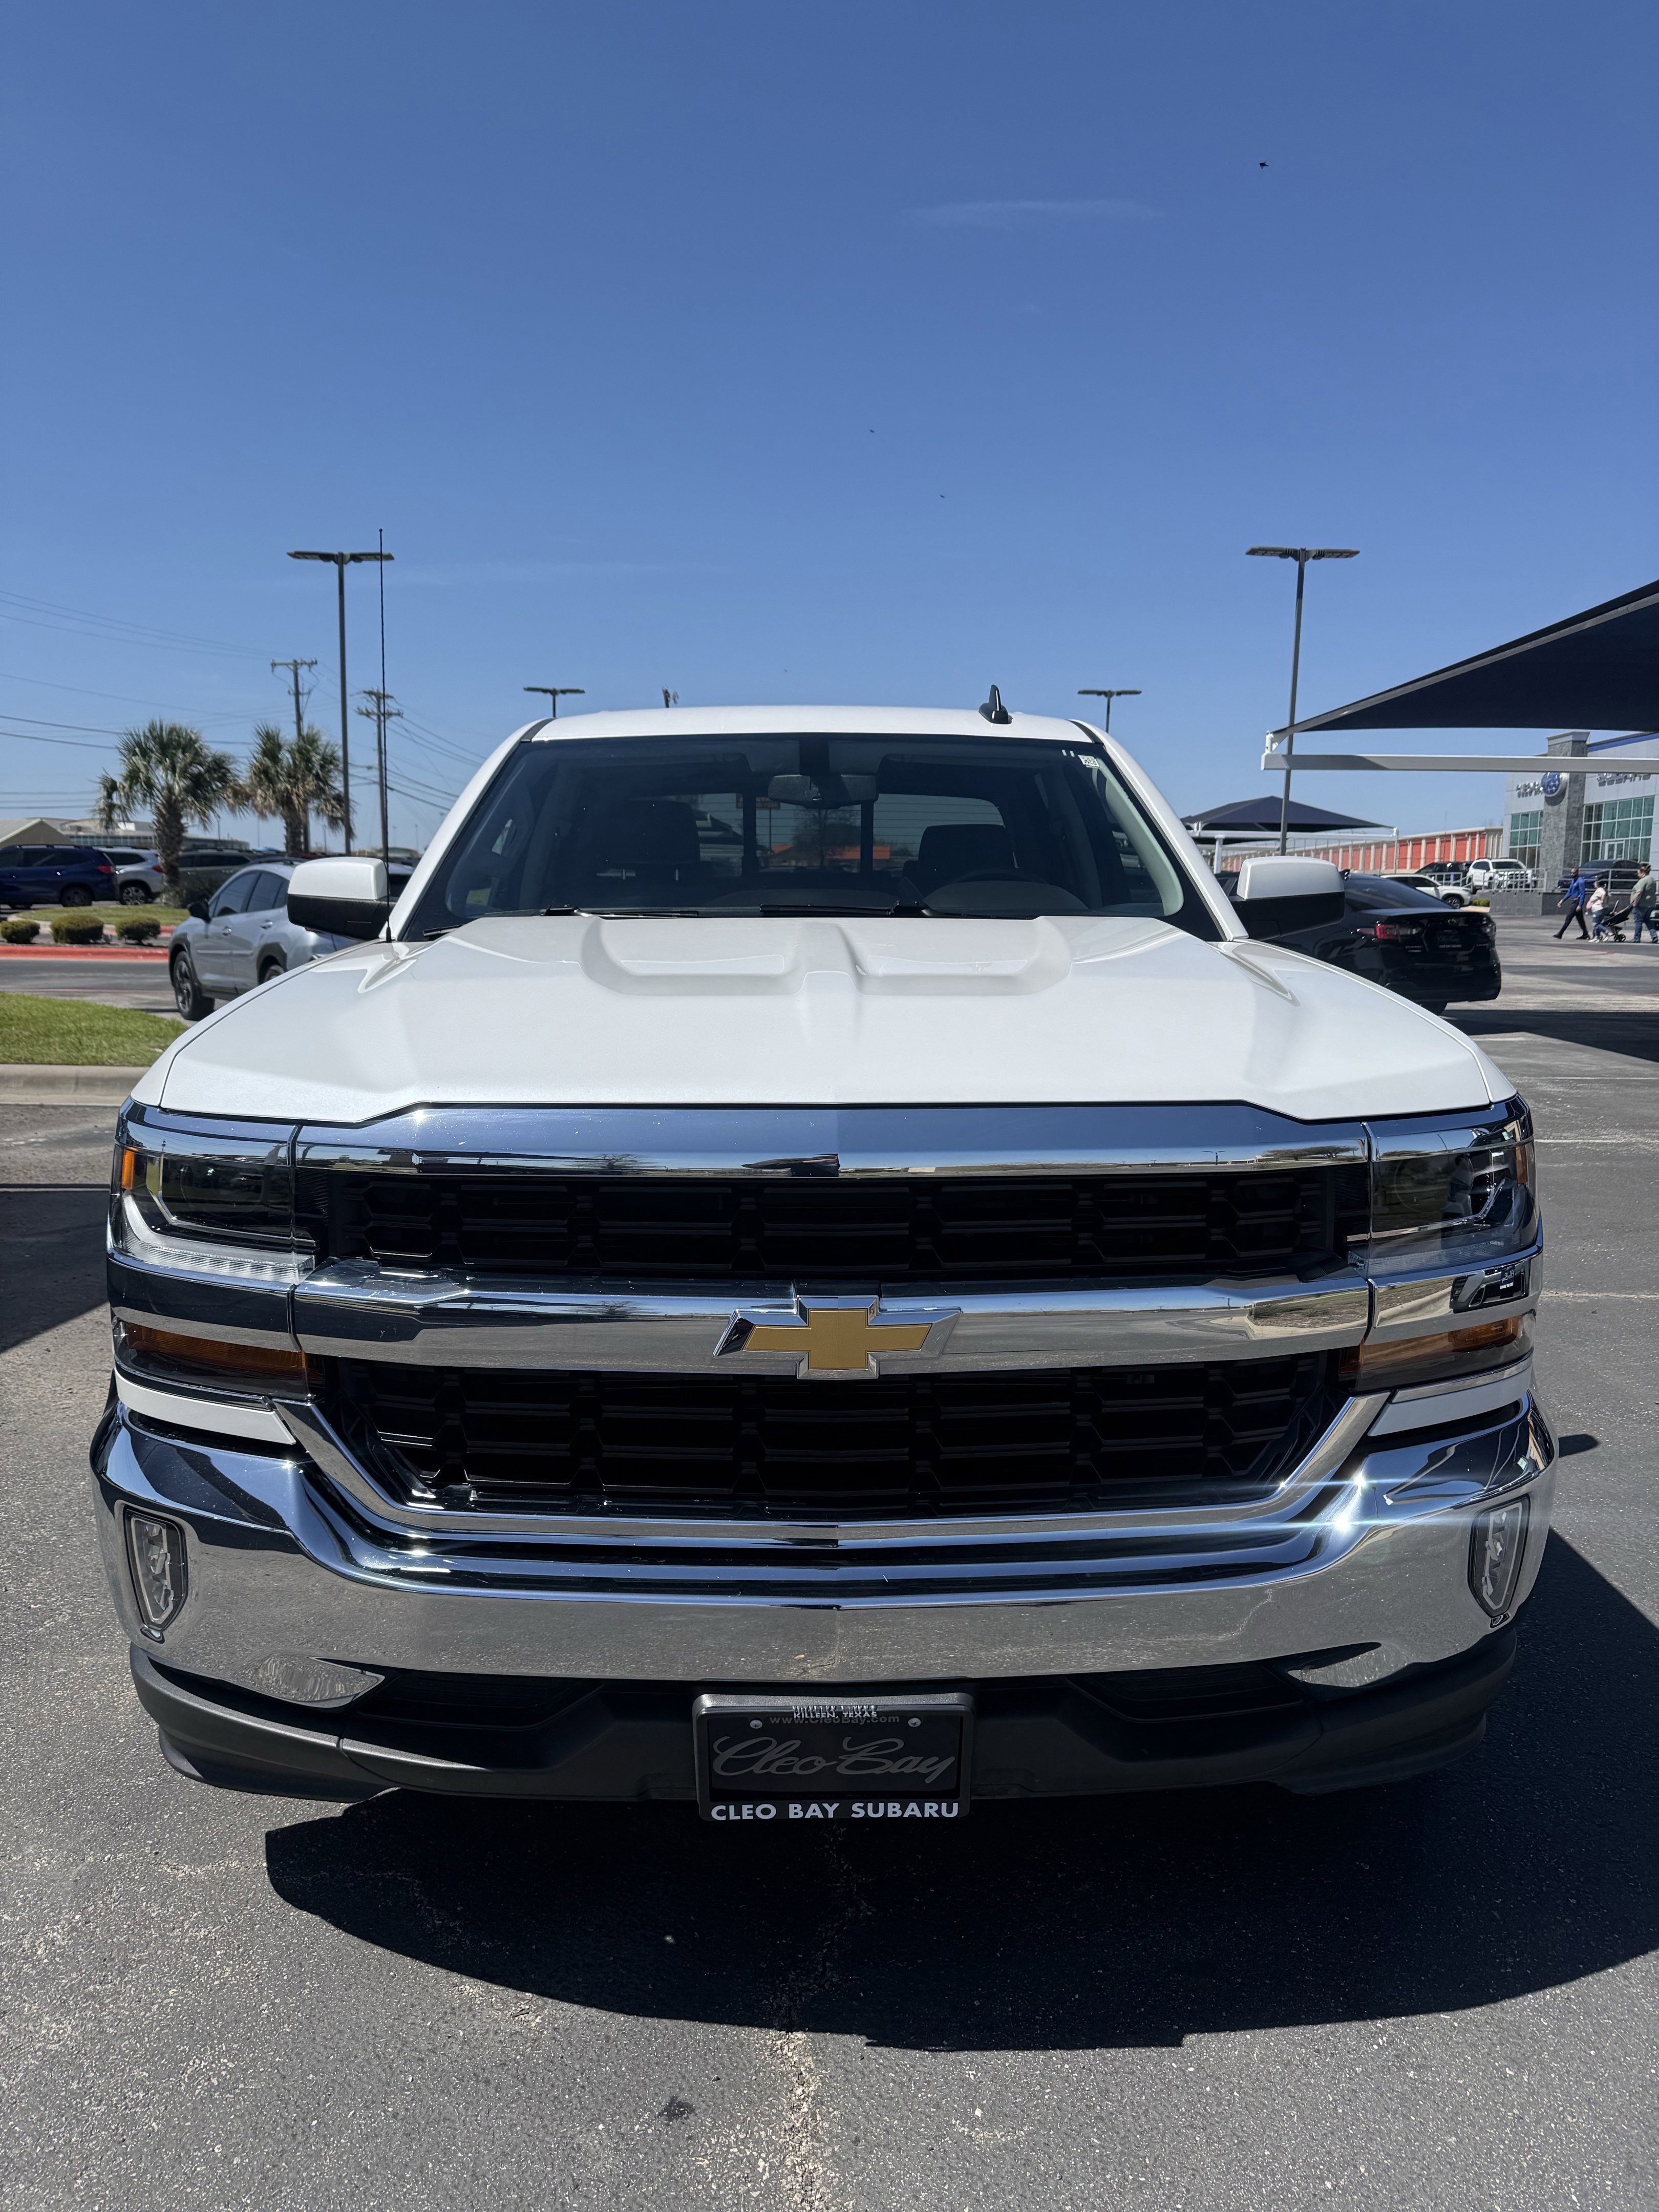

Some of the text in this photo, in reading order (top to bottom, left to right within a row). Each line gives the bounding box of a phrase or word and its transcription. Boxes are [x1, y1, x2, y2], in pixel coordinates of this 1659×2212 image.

[713, 1736, 955, 1783] Cleo Bay
[711, 1802, 959, 1821] CLEO BAY SUBARU
